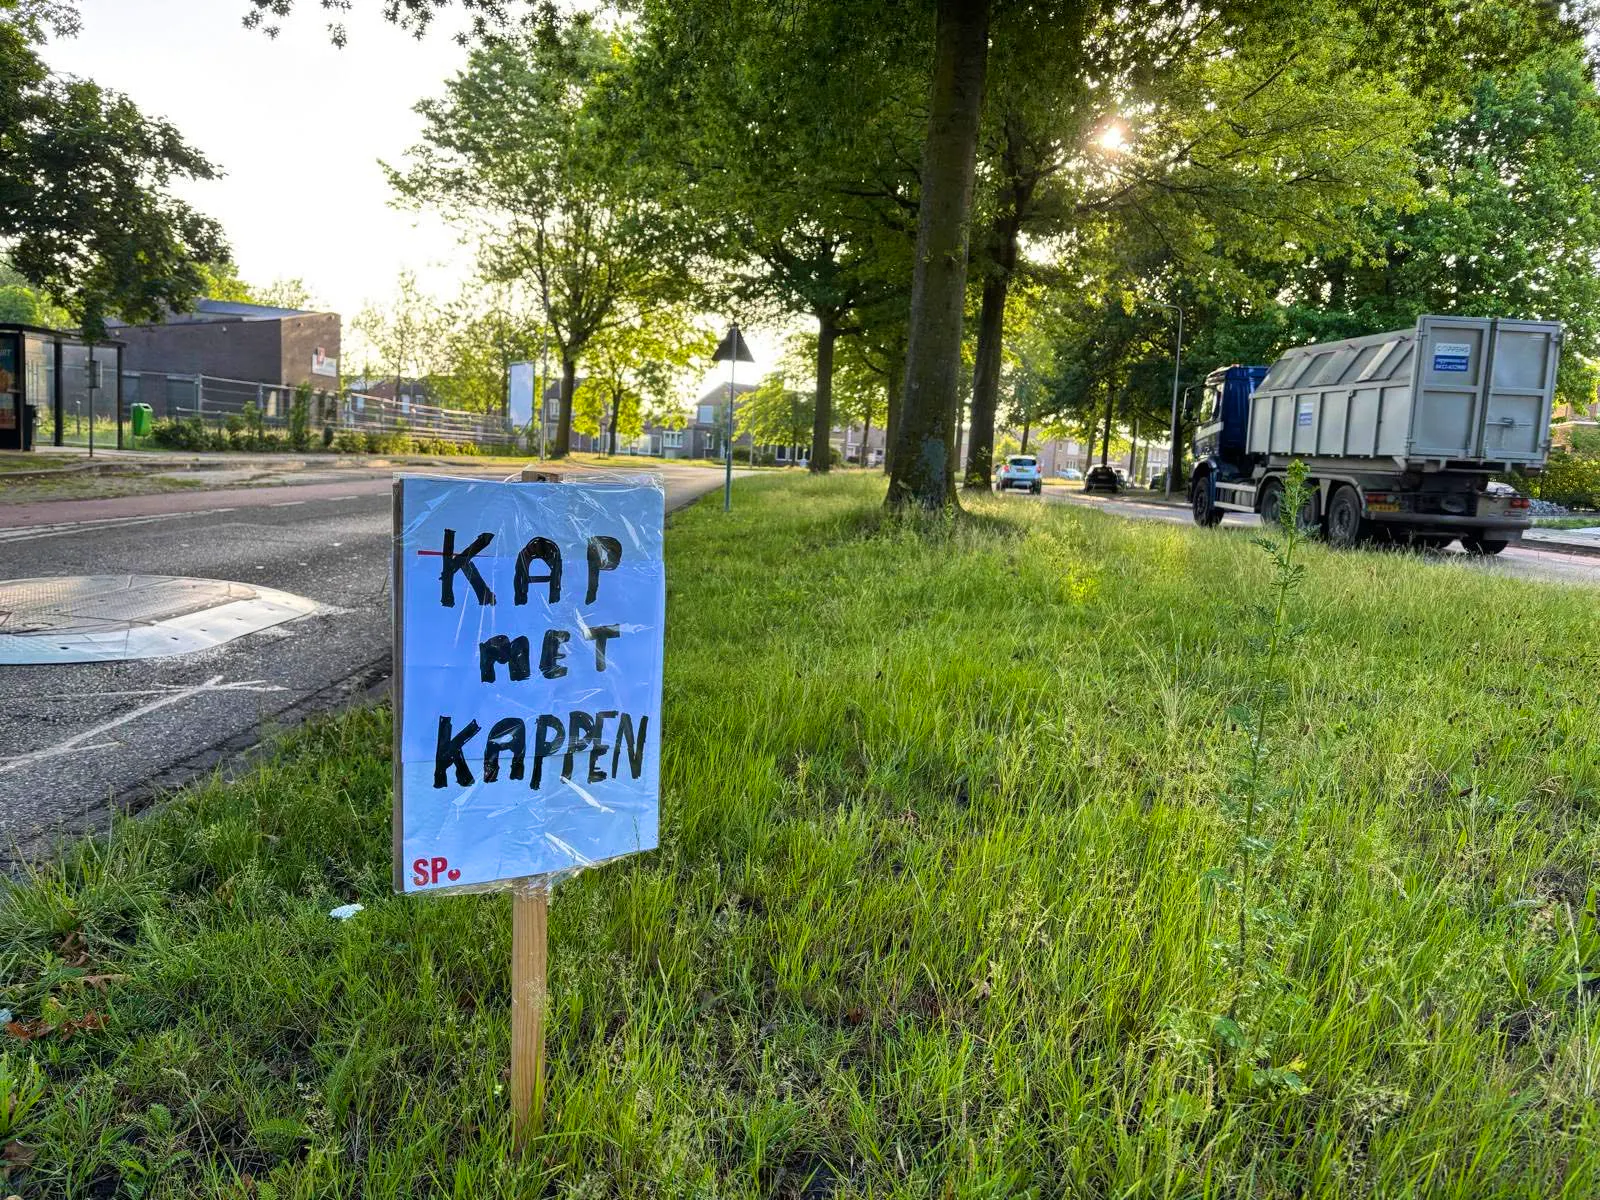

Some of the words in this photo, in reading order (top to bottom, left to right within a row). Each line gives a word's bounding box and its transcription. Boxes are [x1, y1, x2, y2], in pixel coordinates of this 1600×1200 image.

[439, 528, 623, 608] KAP
[478, 623, 620, 684] MET
[432, 710, 649, 791] KAPPEN
